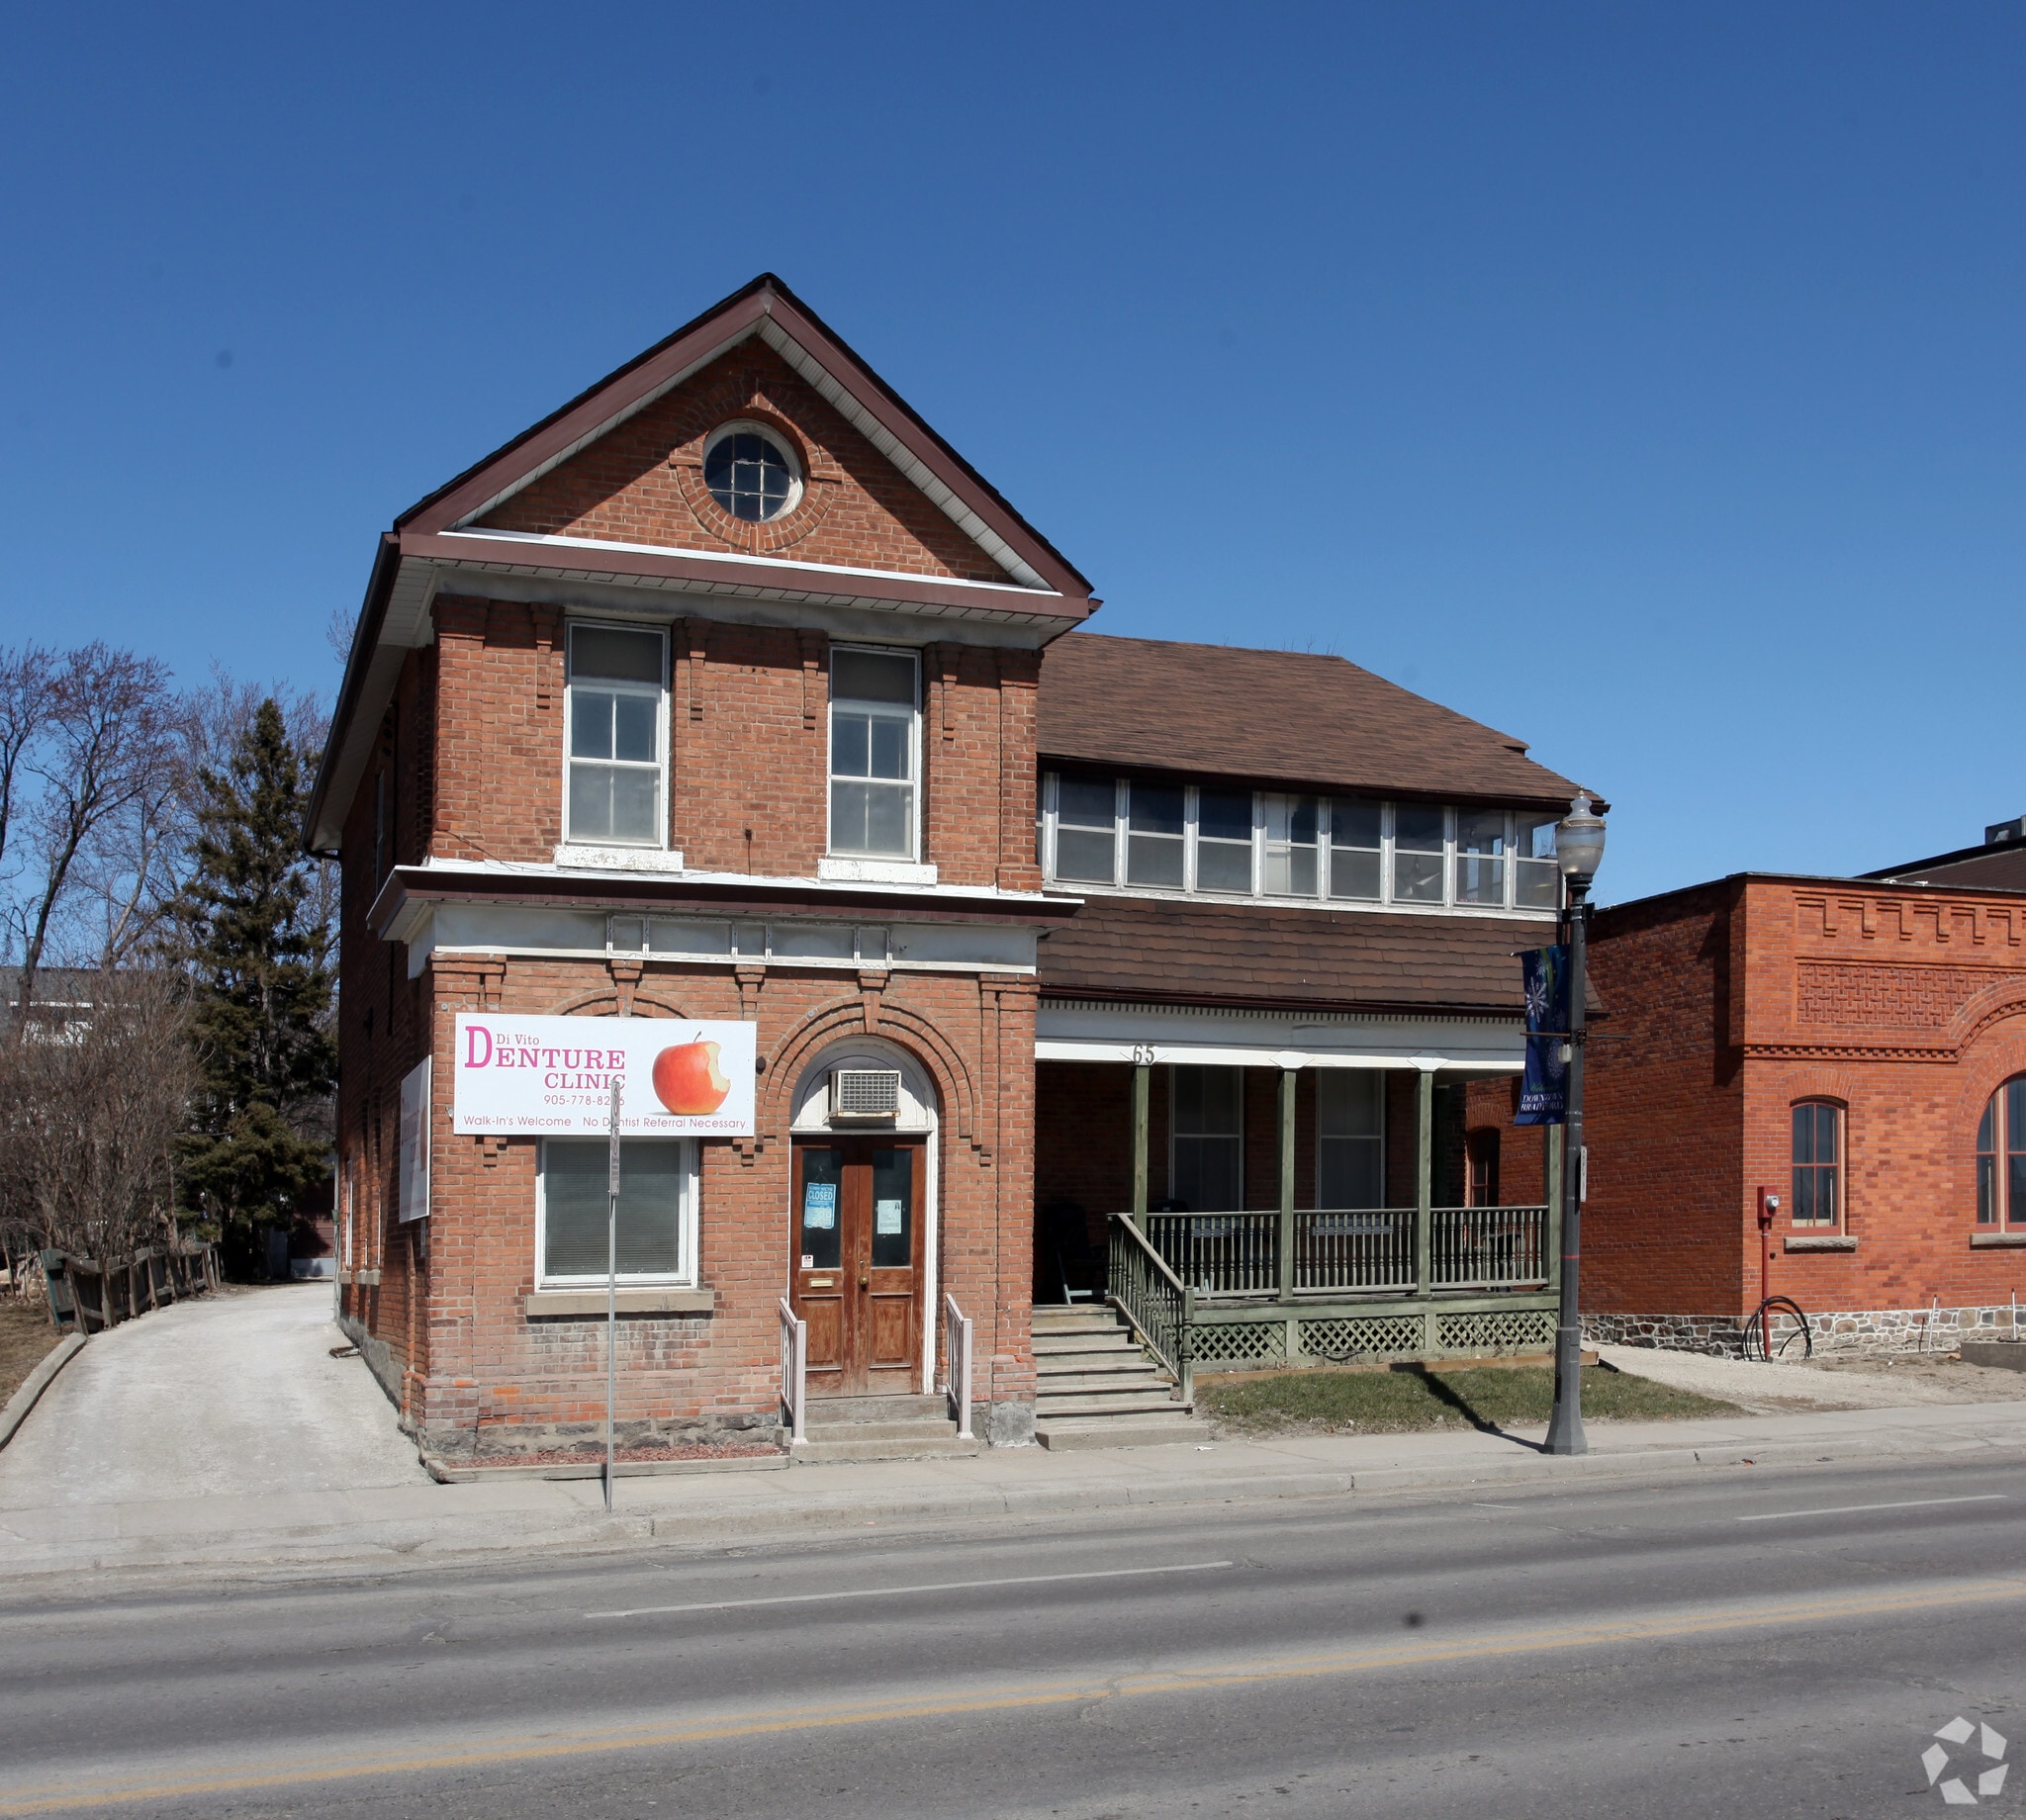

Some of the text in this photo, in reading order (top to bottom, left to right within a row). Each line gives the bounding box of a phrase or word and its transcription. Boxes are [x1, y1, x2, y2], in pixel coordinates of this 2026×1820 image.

[497, 1034, 540, 1046] Di Vito
[464, 1026, 625, 1069] DENTURE
[1133, 1043, 1154, 1064] 65
[544, 1072, 625, 1090] CLINIC
[544, 1095, 625, 1107] 905-778-826
[464, 1116, 746, 1130] Walk-In's Welcome No Dntist Referral Necessary
[808, 1190, 833, 1201] CLOSED
